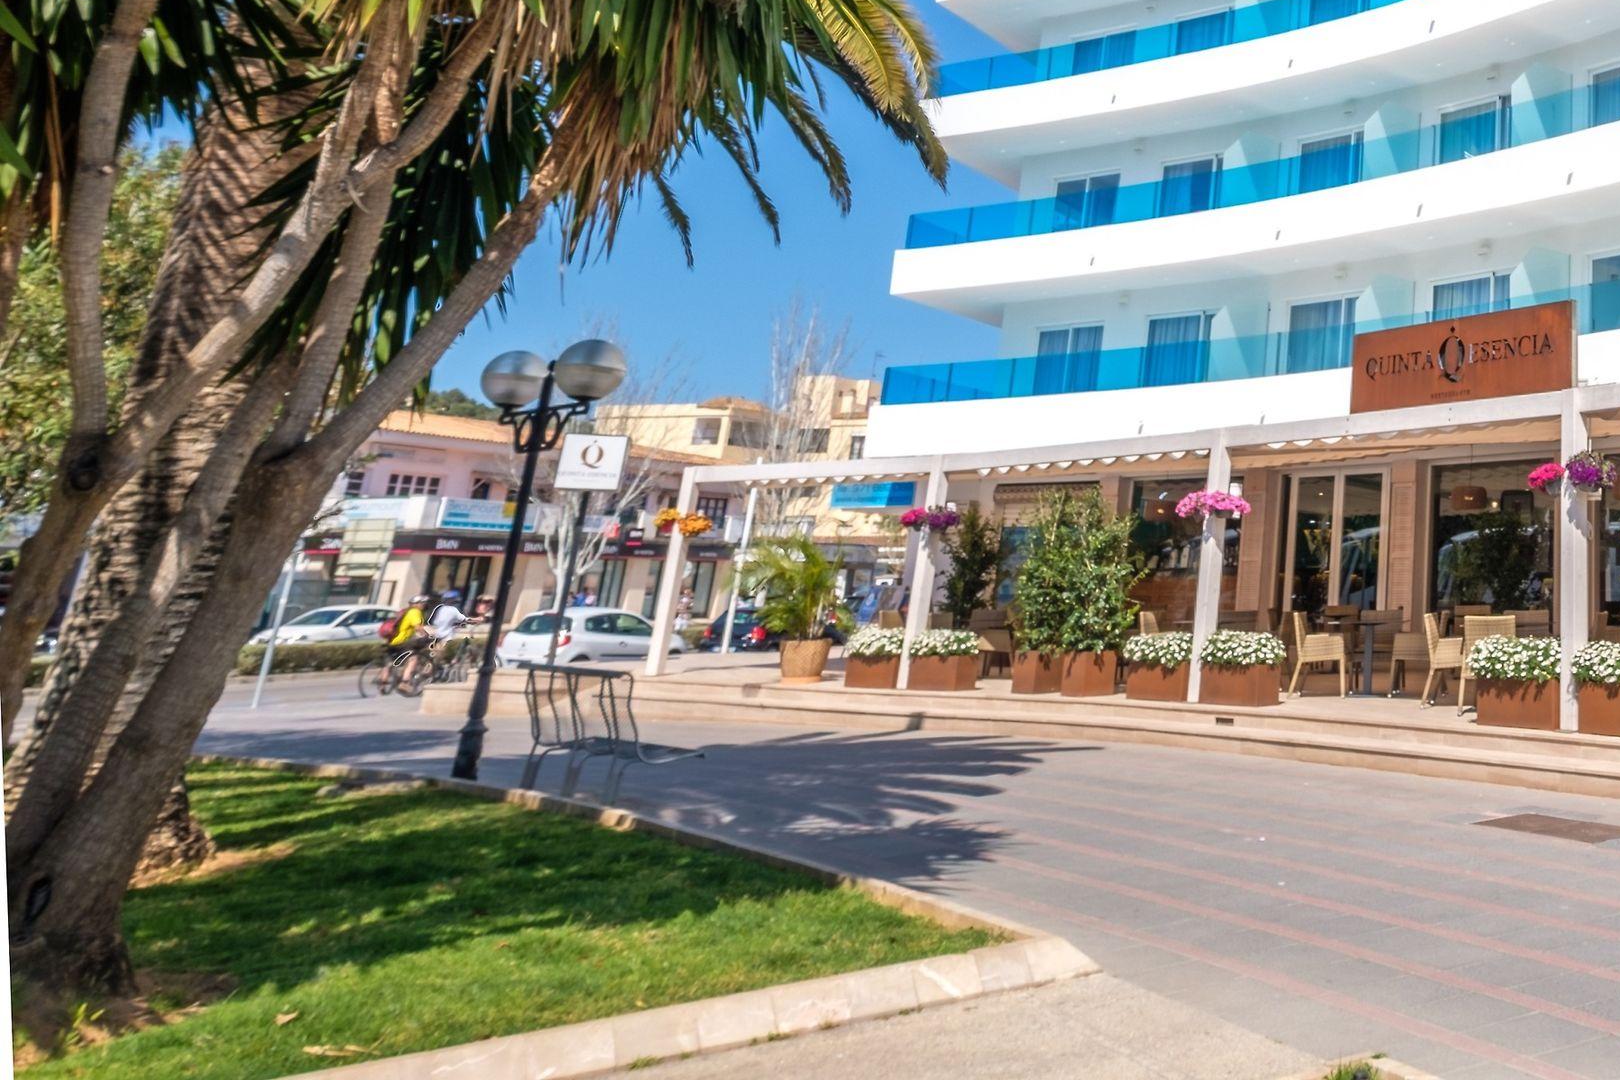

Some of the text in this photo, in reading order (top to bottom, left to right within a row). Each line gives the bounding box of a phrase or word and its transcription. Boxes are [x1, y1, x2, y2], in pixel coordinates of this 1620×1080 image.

[1365, 350, 1434, 381] QUINTA
[1468, 333, 1554, 364] ESENCIA
[581, 444, 604, 469] Q
[435, 539, 460, 550] BMN
